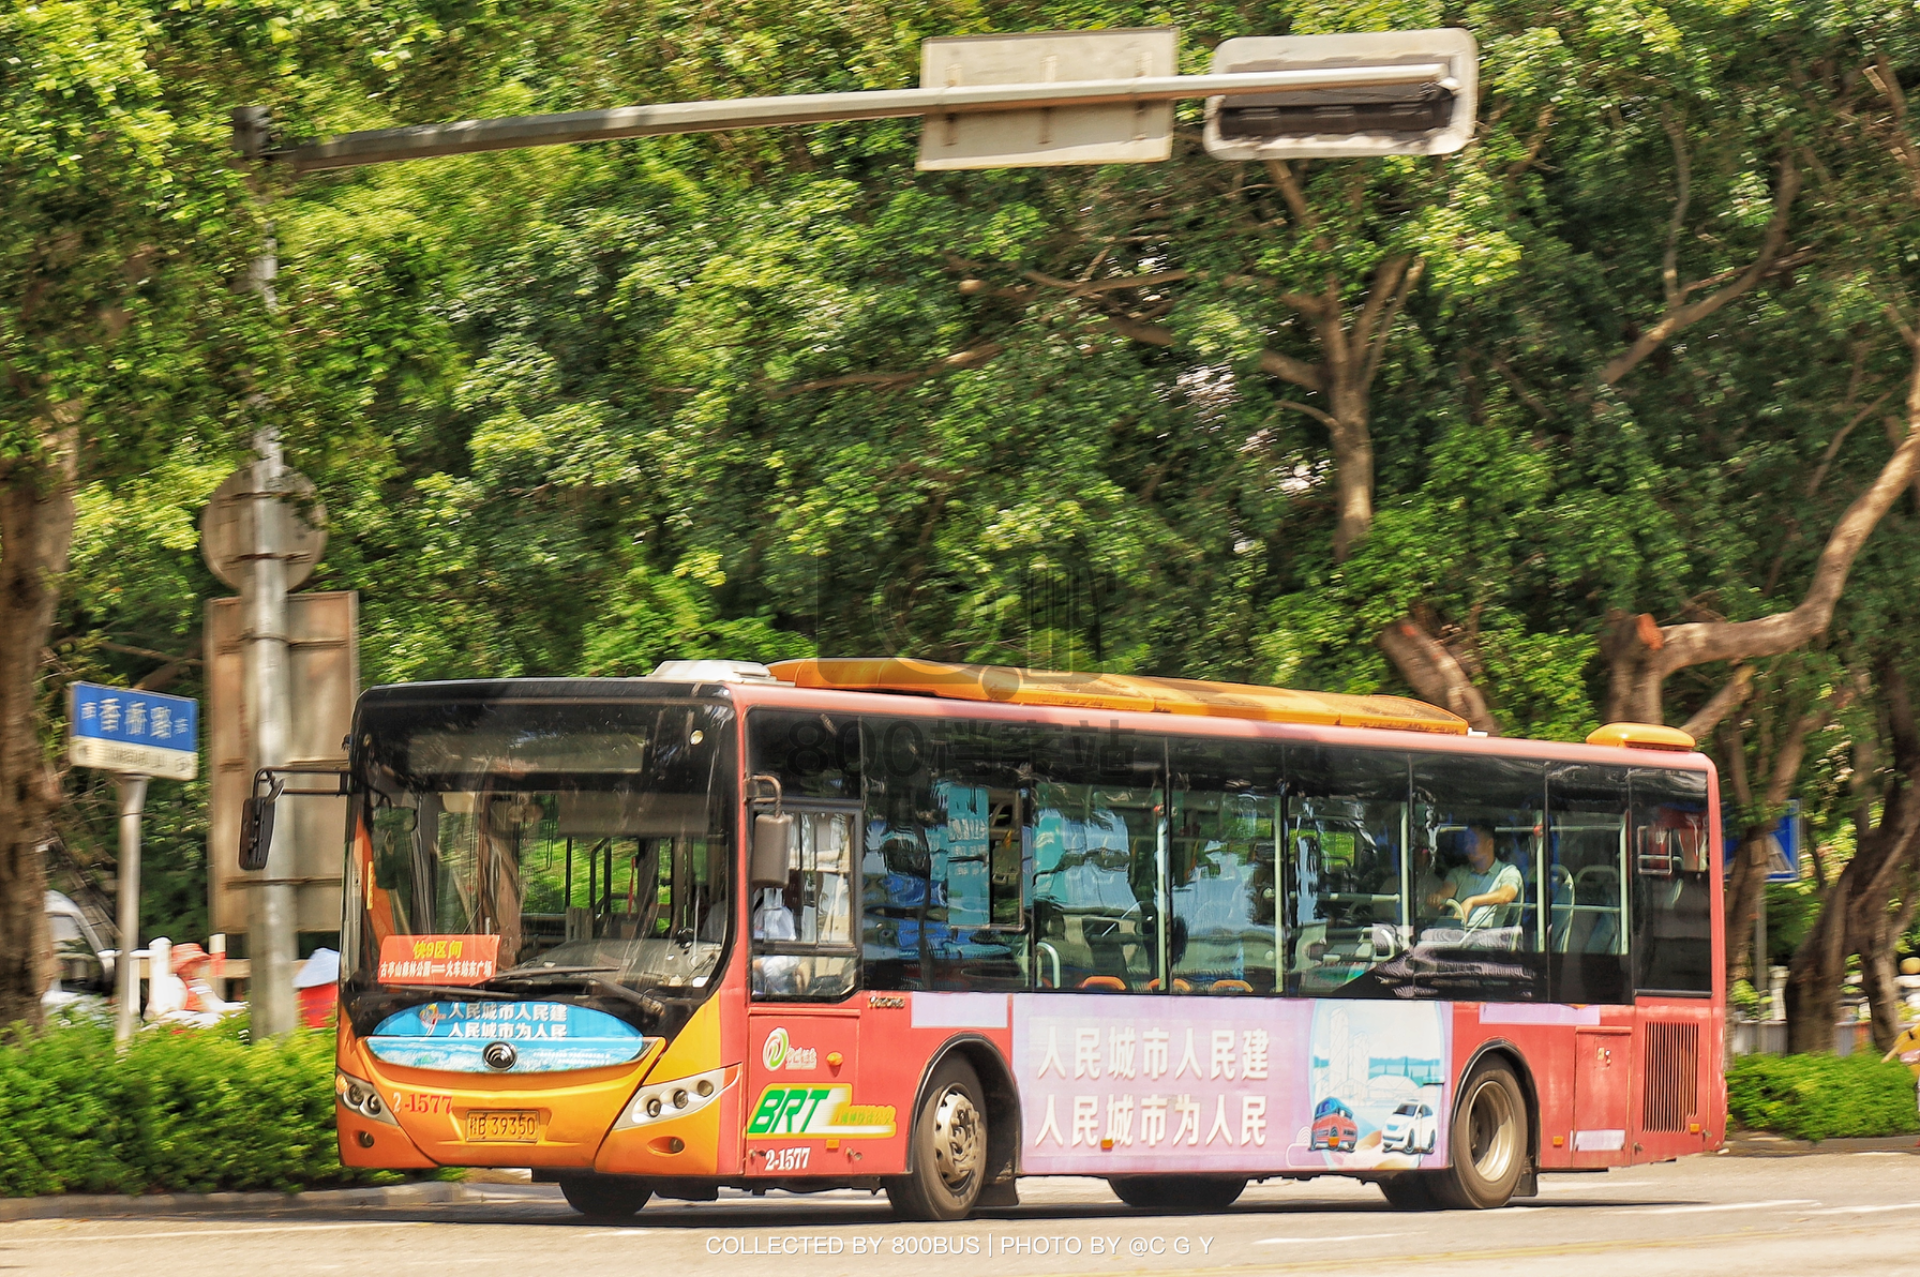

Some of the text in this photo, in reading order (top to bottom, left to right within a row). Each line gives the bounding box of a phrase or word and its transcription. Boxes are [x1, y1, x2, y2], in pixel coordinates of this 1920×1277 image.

[413, 940, 463, 959] 快9区间
[449, 1003, 568, 1021] 人民城市人民建
[448, 1022, 568, 1041] 人民城市为人民
[1037, 1025, 1270, 1080] 人民城市人民建
[392, 1091, 453, 1115] 2-1577
[748, 1089, 831, 1134] BRT
[1035, 1094, 1267, 1147] 人民城市为人民
[764, 1147, 811, 1171] 2-1577
